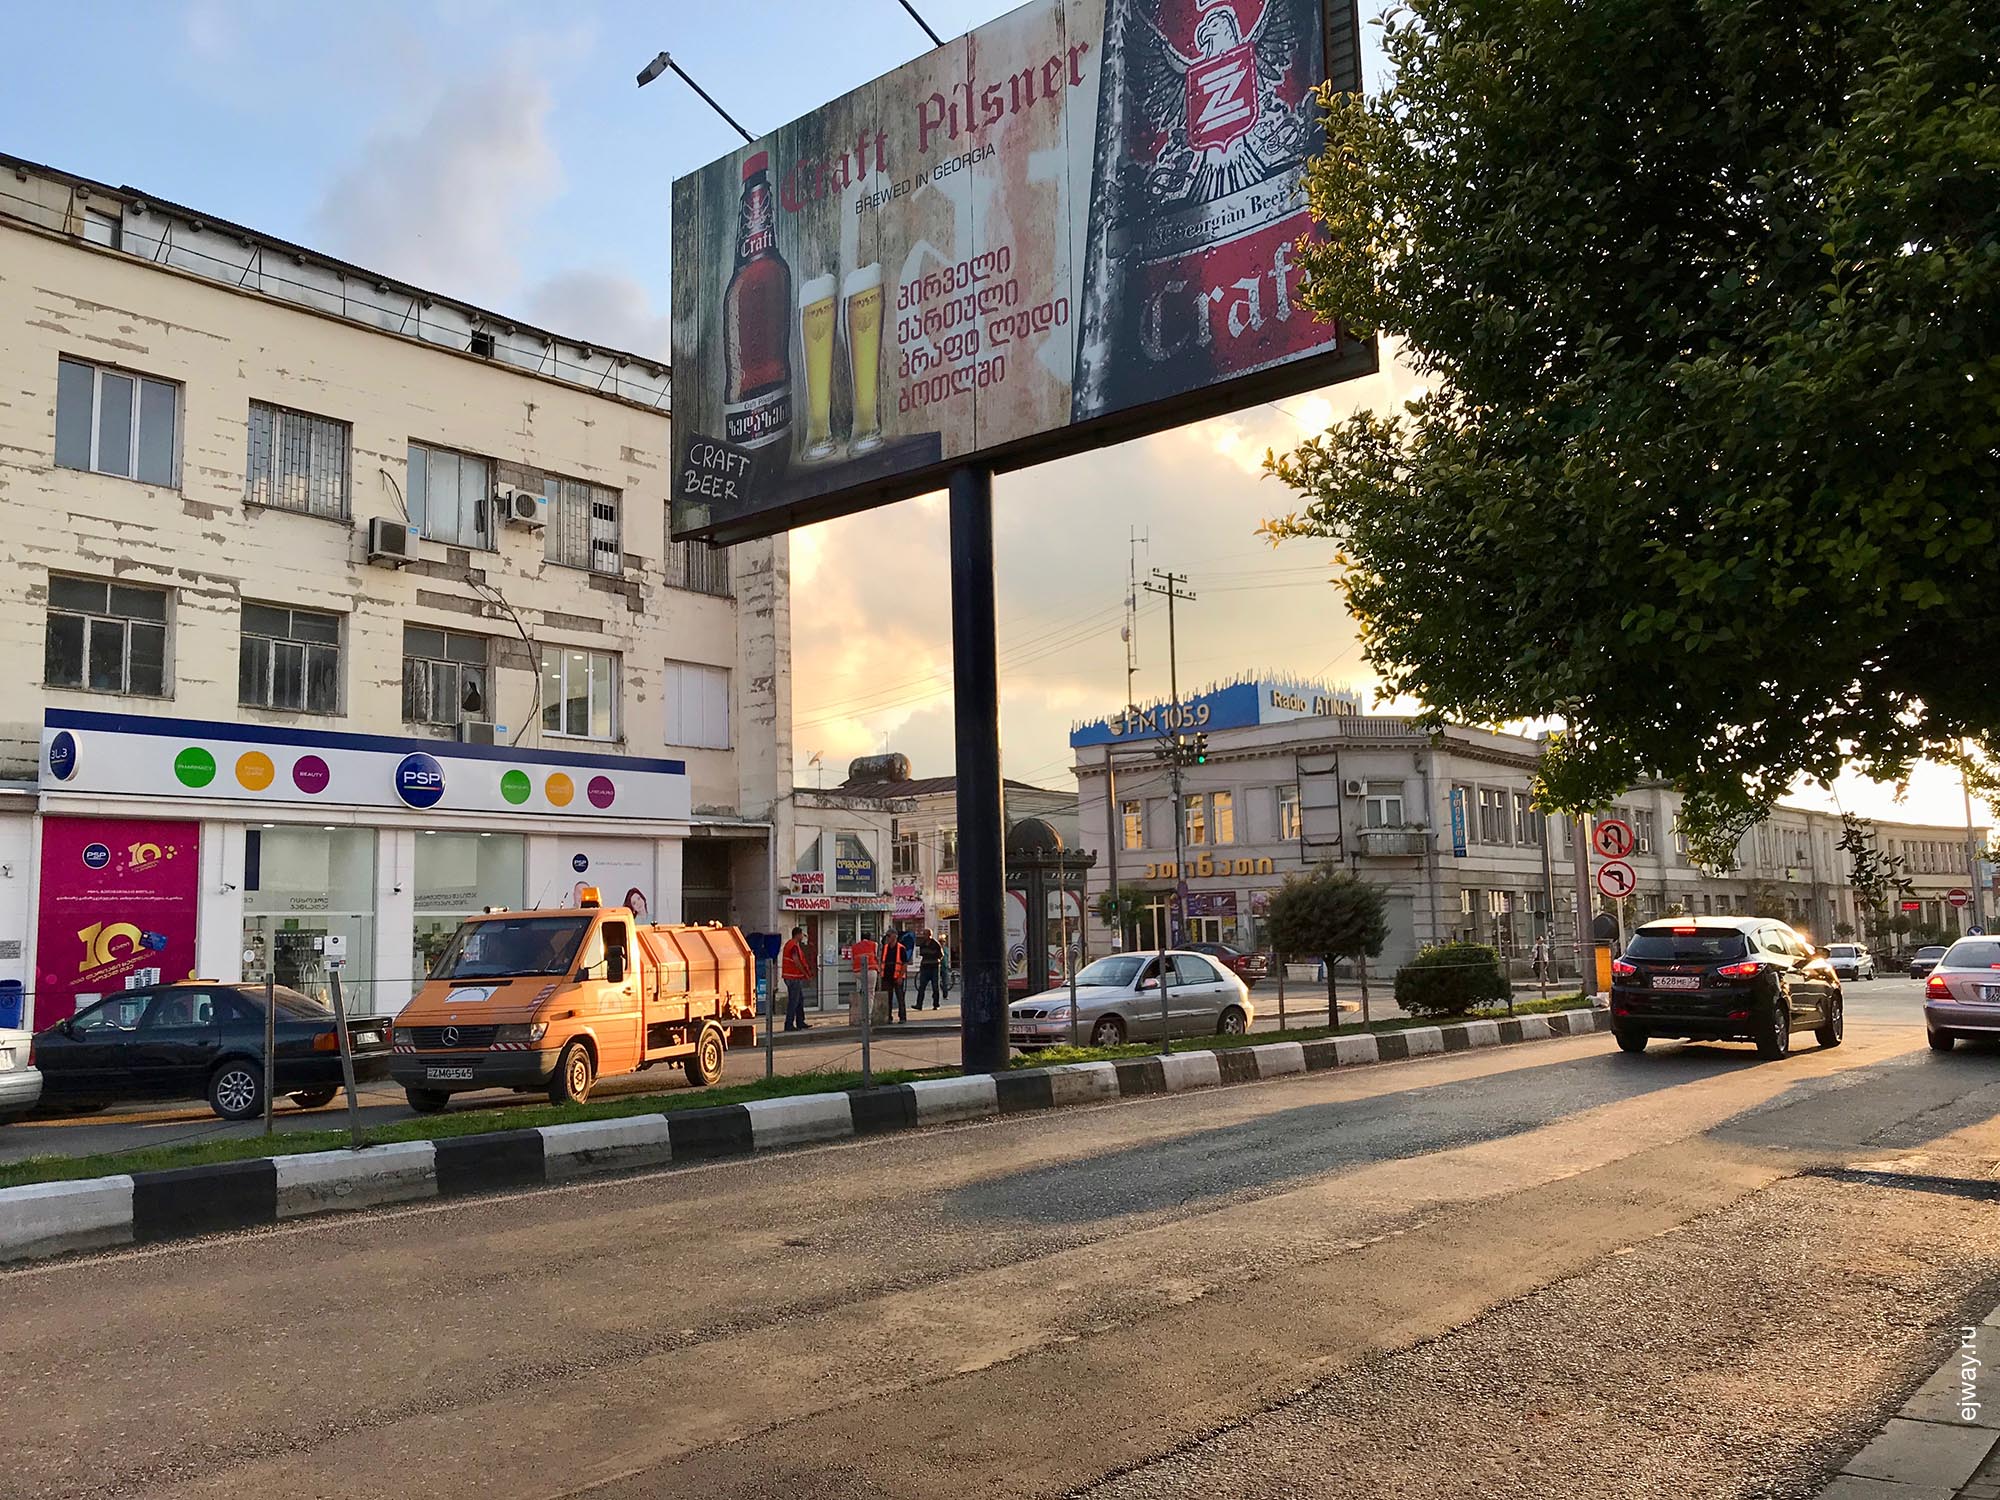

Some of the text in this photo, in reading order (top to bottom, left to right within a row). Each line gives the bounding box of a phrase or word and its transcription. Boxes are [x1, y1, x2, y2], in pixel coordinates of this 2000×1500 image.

[780, 40, 1090, 213] Craft Pilsner
[855, 142, 997, 215] BREWED IN GEORGIA
[1247, 189, 1287, 216] Beer
[740, 230, 773, 258] Craft
[896, 245, 1011, 312] პირველი
[1138, 241, 1312, 362] Craf
[897, 278, 1019, 345] ქართული
[898, 297, 1069, 379] კრაფტ ლუდი
[898, 354, 1006, 414] ბოთლში
[689, 443, 751, 478] CRAFT
[684, 469, 739, 500] BEER
[1126, 703, 1211, 735] FM 105.9
[1270, 689, 1307, 712] Radio
[403, 770, 441, 785] PSP
